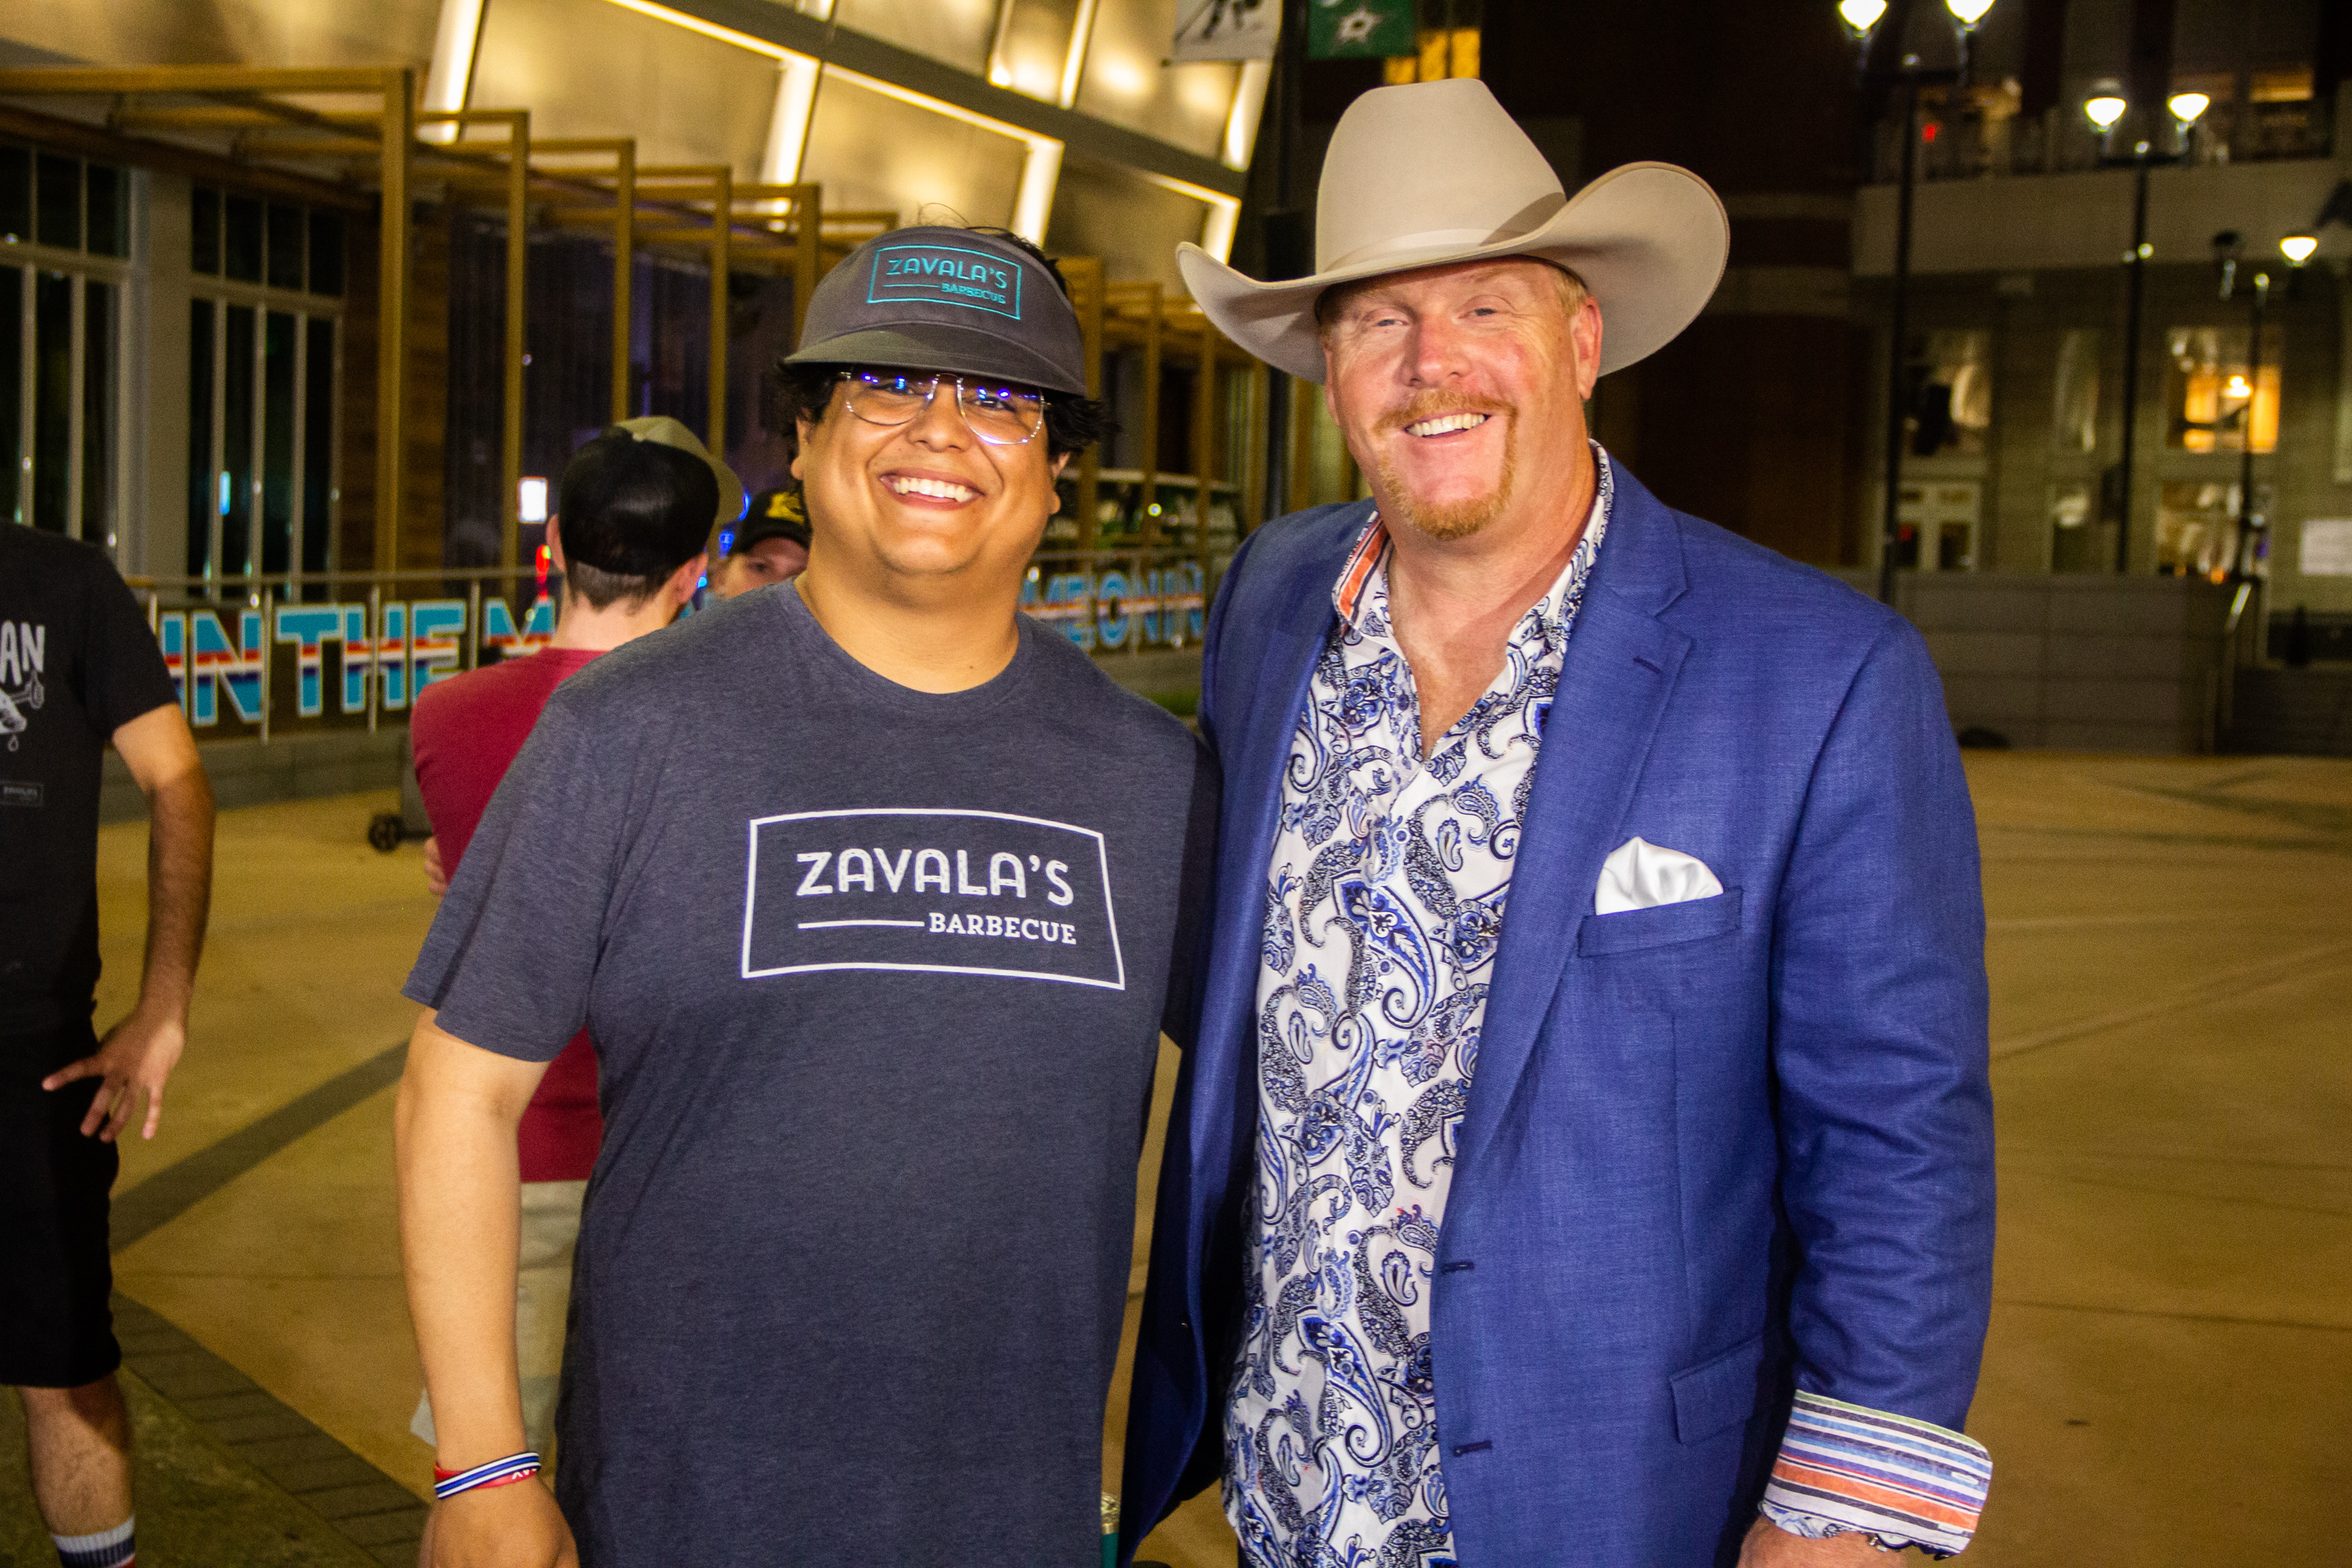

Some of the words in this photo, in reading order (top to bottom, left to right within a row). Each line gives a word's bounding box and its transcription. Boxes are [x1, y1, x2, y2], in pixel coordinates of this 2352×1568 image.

[886, 257, 1007, 289] ZAVALA'S
[941, 282, 1006, 304] BARBECUE
[275, 599, 466, 716] THE
[796, 848, 1074, 906] ZAVALA'S
[928, 912, 1076, 946] BARBECUE
